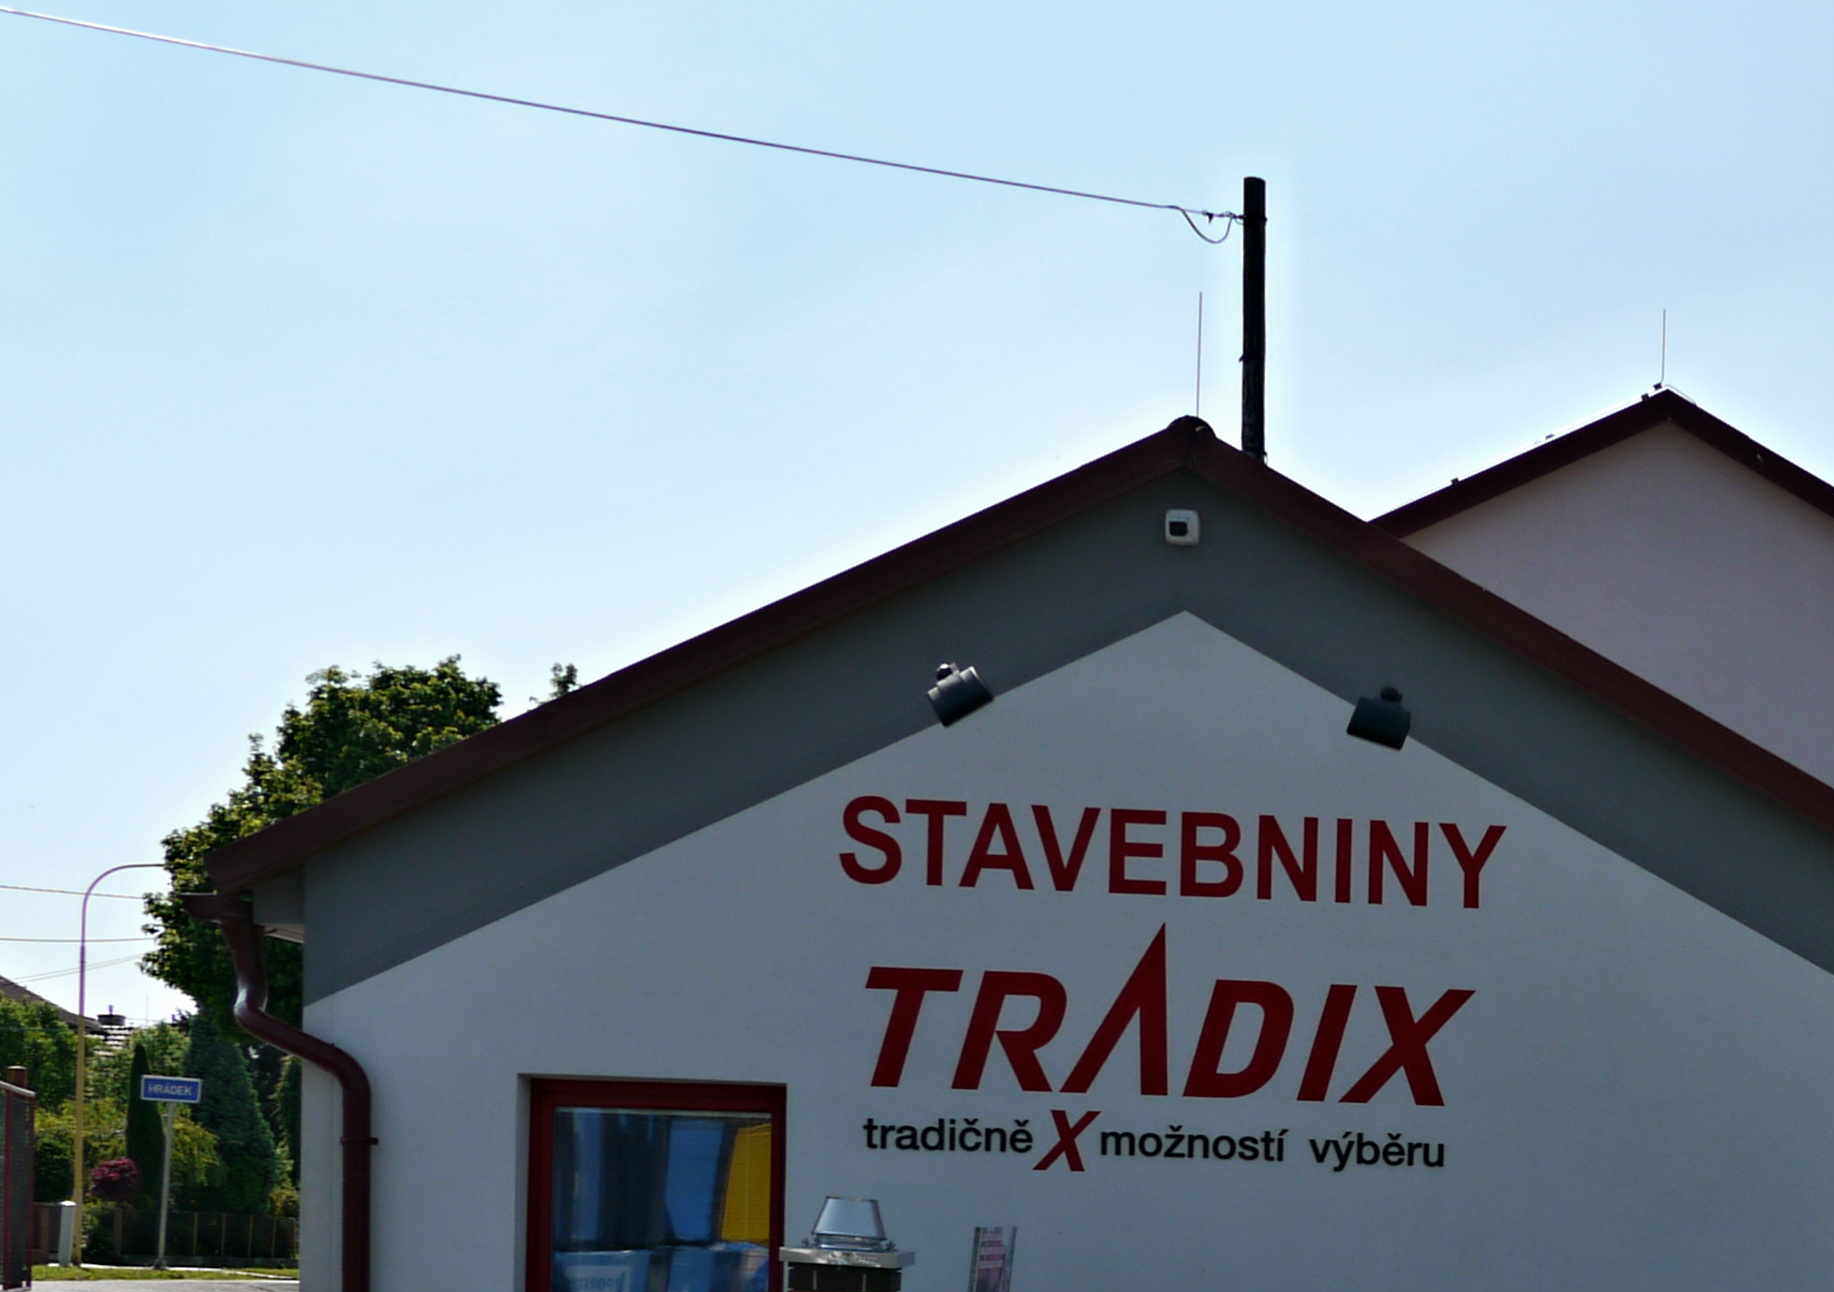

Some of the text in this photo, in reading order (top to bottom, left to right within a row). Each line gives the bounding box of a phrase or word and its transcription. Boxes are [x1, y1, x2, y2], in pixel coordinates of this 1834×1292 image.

[839, 795, 1507, 909] STAVEBNINY
[865, 922, 1476, 1106] TRADIX
[148, 1082, 193, 1096] HRÁDEK
[862, 1109, 1446, 1173] tradičně X možností výběru
